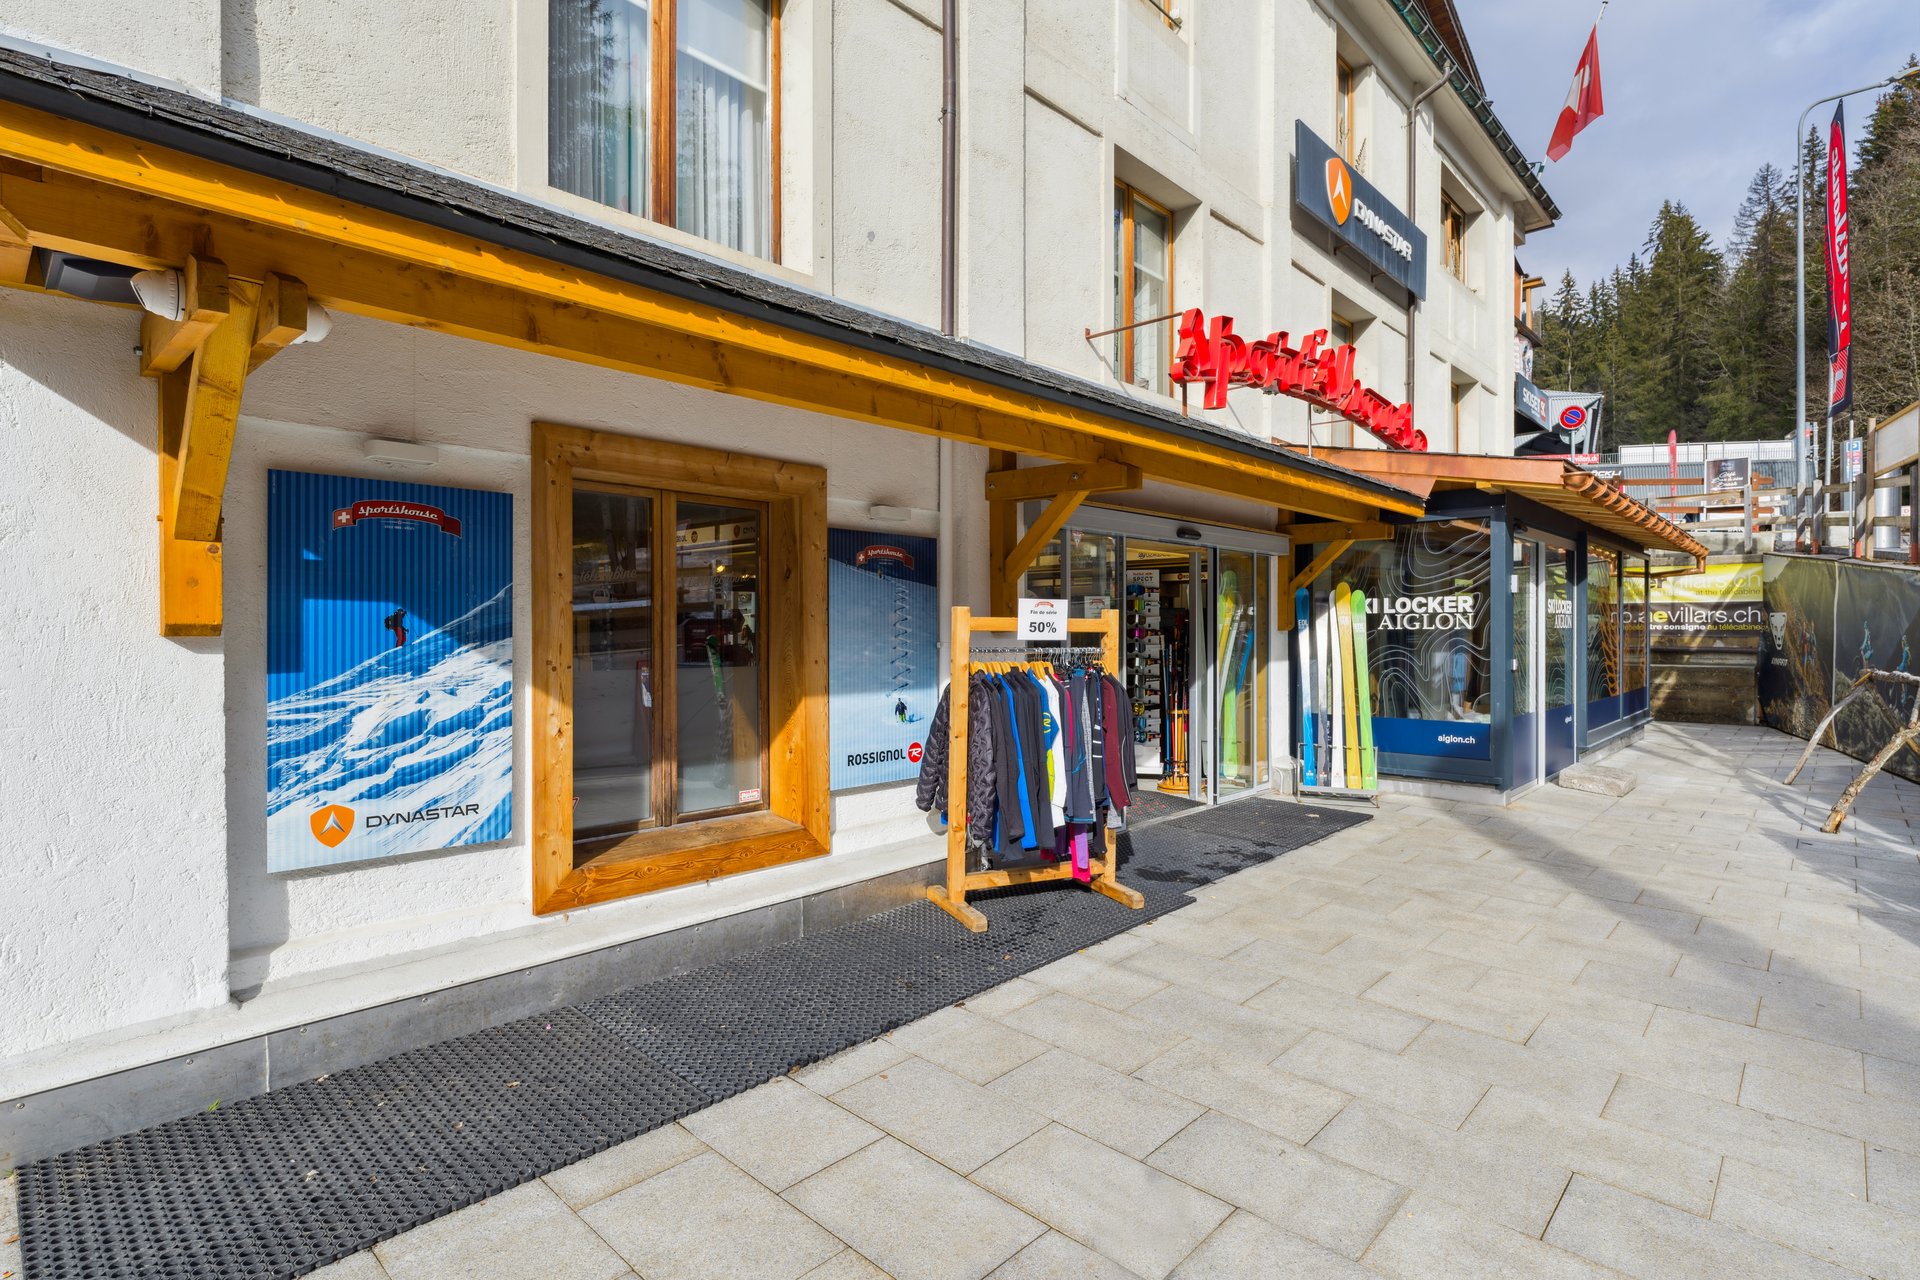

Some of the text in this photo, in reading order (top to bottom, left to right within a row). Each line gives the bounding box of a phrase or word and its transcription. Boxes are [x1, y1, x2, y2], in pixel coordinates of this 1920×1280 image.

[1354, 198, 1412, 261] DYNASTAR
[1365, 596, 1473, 614] KI LOCKER
[1378, 613, 1474, 630] AIGLON
[1650, 606, 1761, 623] evillars.ch
[1029, 621, 1057, 633] 50%
[1664, 624, 1706, 632] consigne
[1719, 623, 1761, 631] télécabine
[1437, 733, 1476, 744] aiglon.ch
[847, 748, 906, 767] ROSSIGNOL
[366, 803, 480, 828] DYNASTAR
